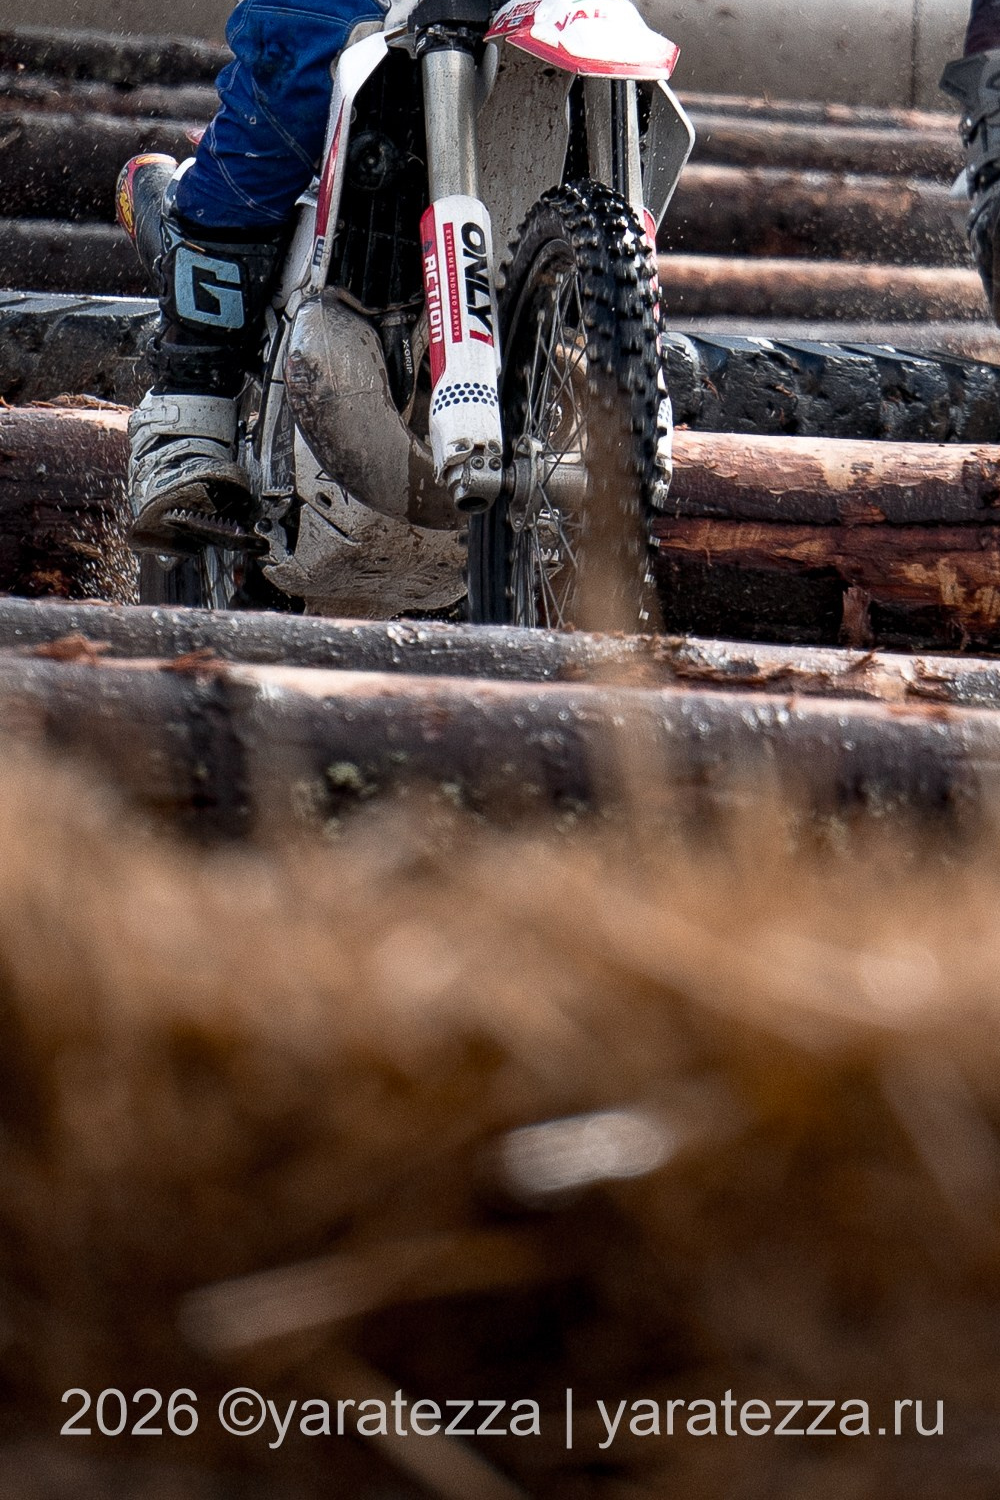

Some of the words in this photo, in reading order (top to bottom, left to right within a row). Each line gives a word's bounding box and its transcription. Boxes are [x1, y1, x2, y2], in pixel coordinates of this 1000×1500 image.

[445, 229, 454, 269] EXTREME
[424, 253, 443, 344] ACTION
[448, 271, 458, 307] ENDURO
[452, 309, 460, 337] PARTS
